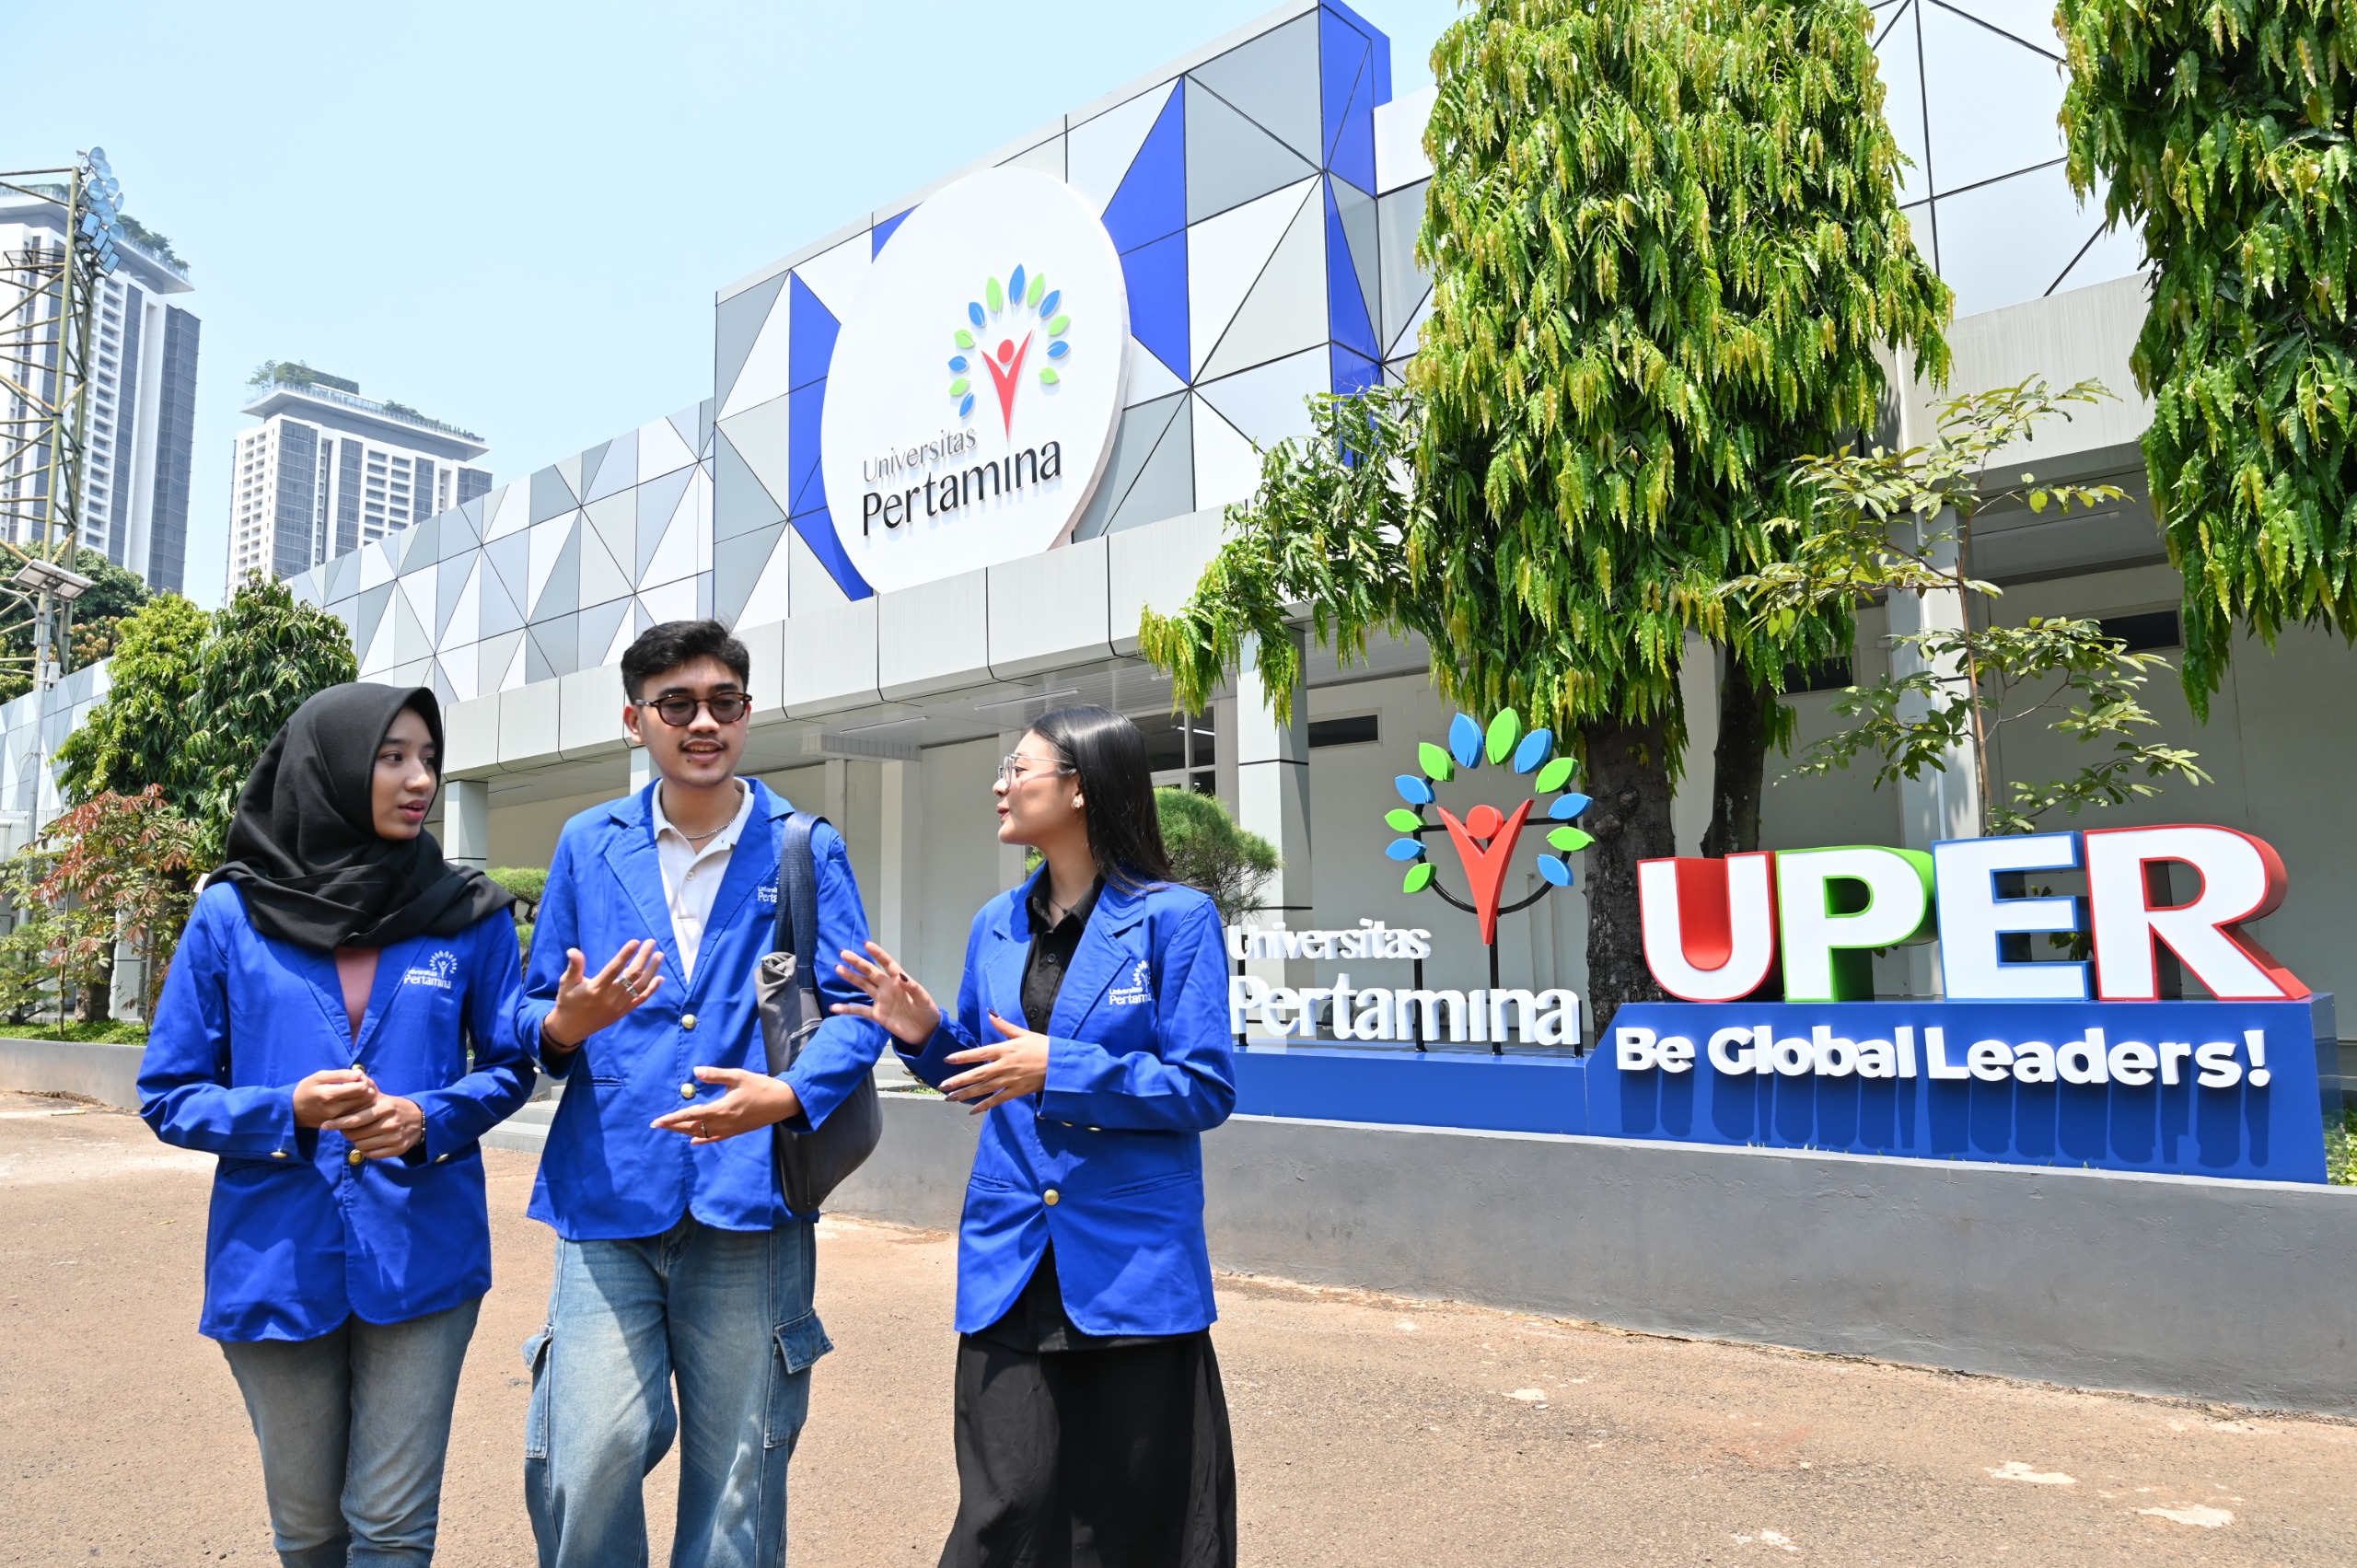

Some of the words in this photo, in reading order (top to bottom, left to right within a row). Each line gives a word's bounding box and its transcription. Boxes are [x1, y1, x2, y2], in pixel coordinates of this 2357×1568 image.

[863, 427, 977, 483] Universitas
[862, 439, 1062, 538] Pertamina
[1227, 917, 1432, 960] Universitas
[1637, 824, 2312, 1003] UPER
[403, 974, 452, 989] Pertamina
[1228, 972, 1581, 1046] Pertamina
[1616, 1027, 1696, 1074] Be
[1708, 1025, 1917, 1078] Global
[1924, 1027, 2271, 1088] Leaders!
